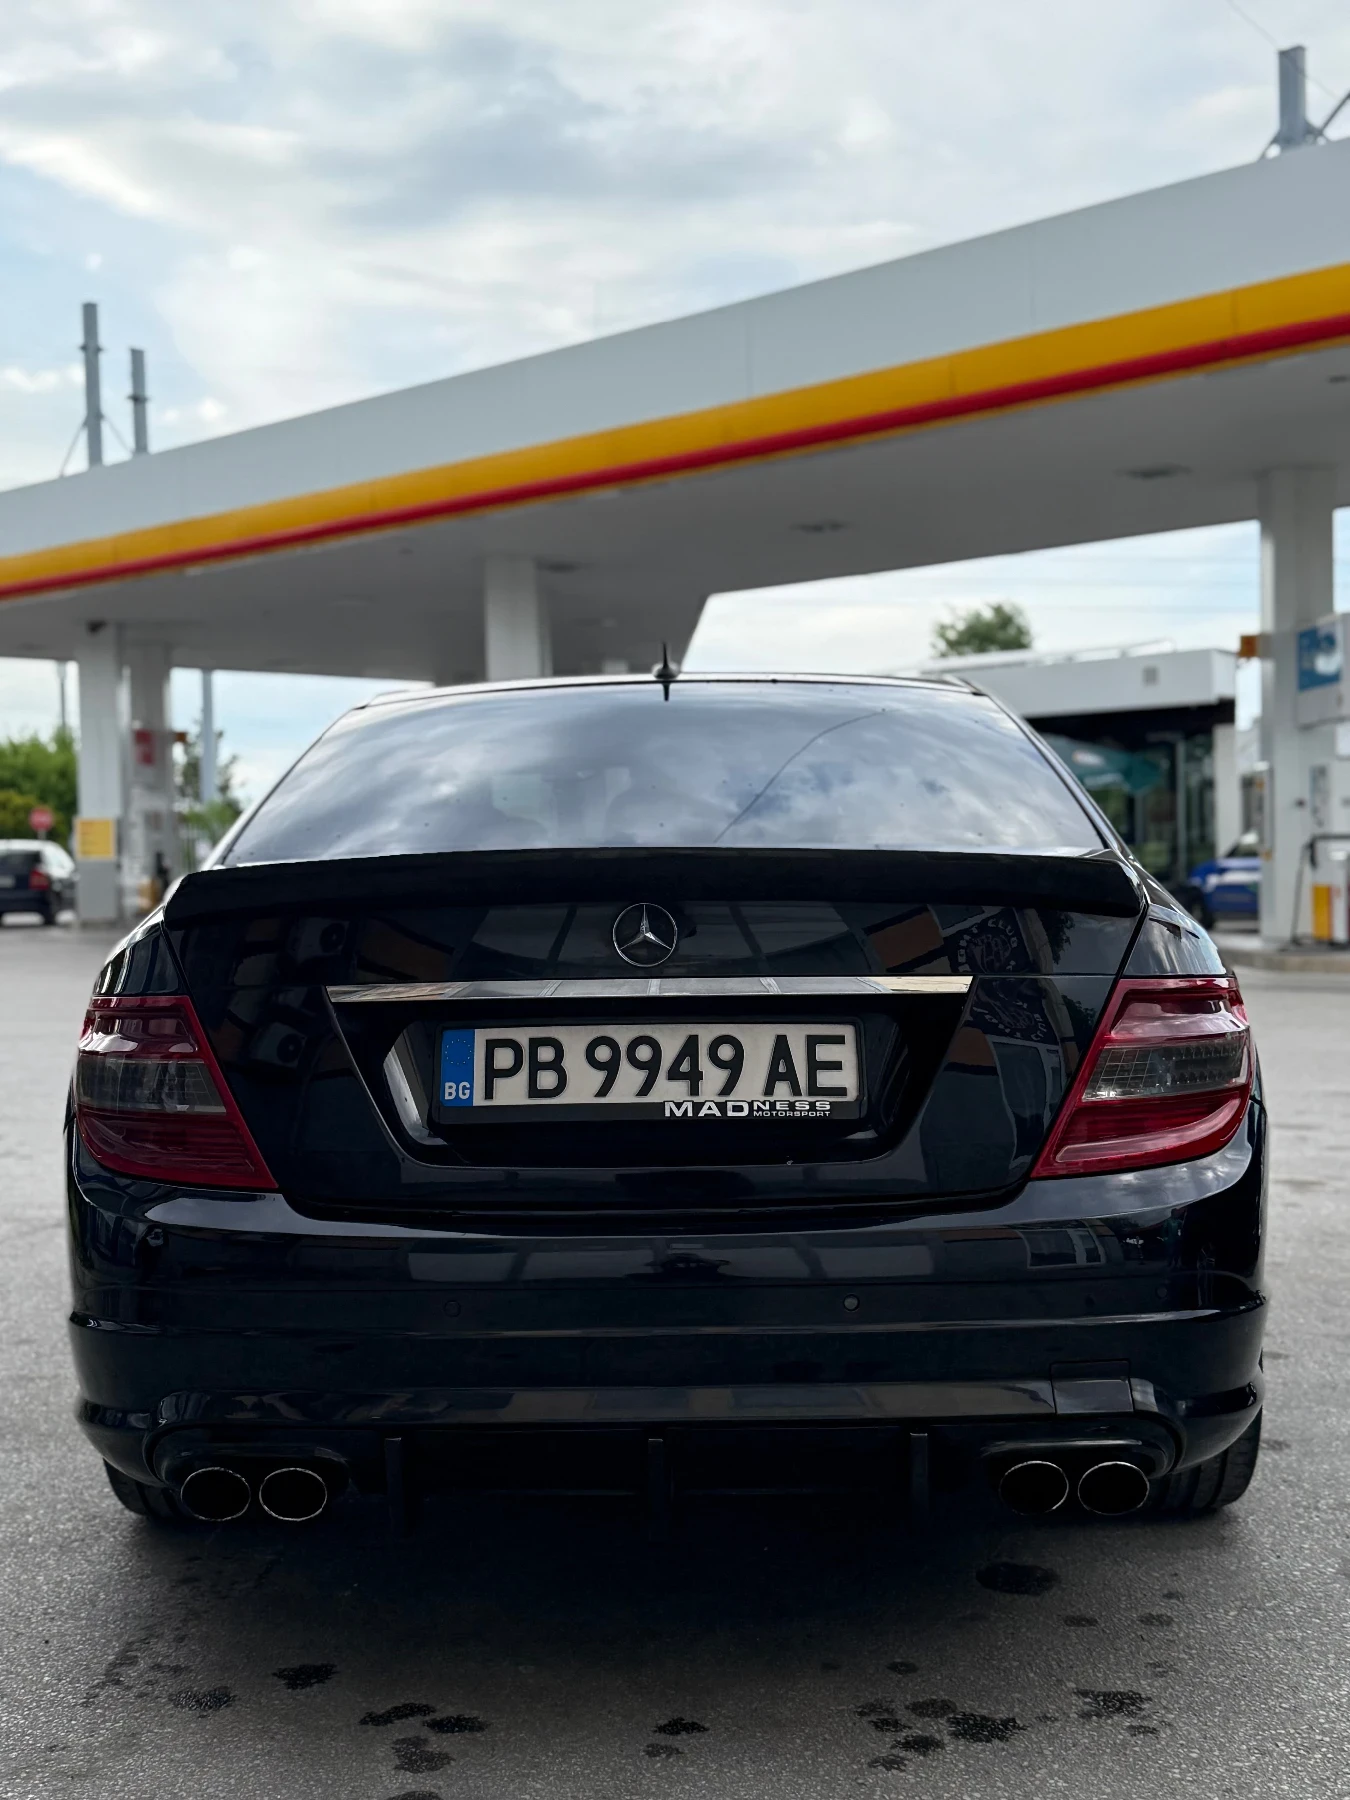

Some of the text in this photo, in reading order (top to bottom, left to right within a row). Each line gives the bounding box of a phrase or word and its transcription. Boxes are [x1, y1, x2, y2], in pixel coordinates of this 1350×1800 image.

[484, 1034, 848, 1100] PB 9949 AE
[444, 1082, 471, 1100] BG
